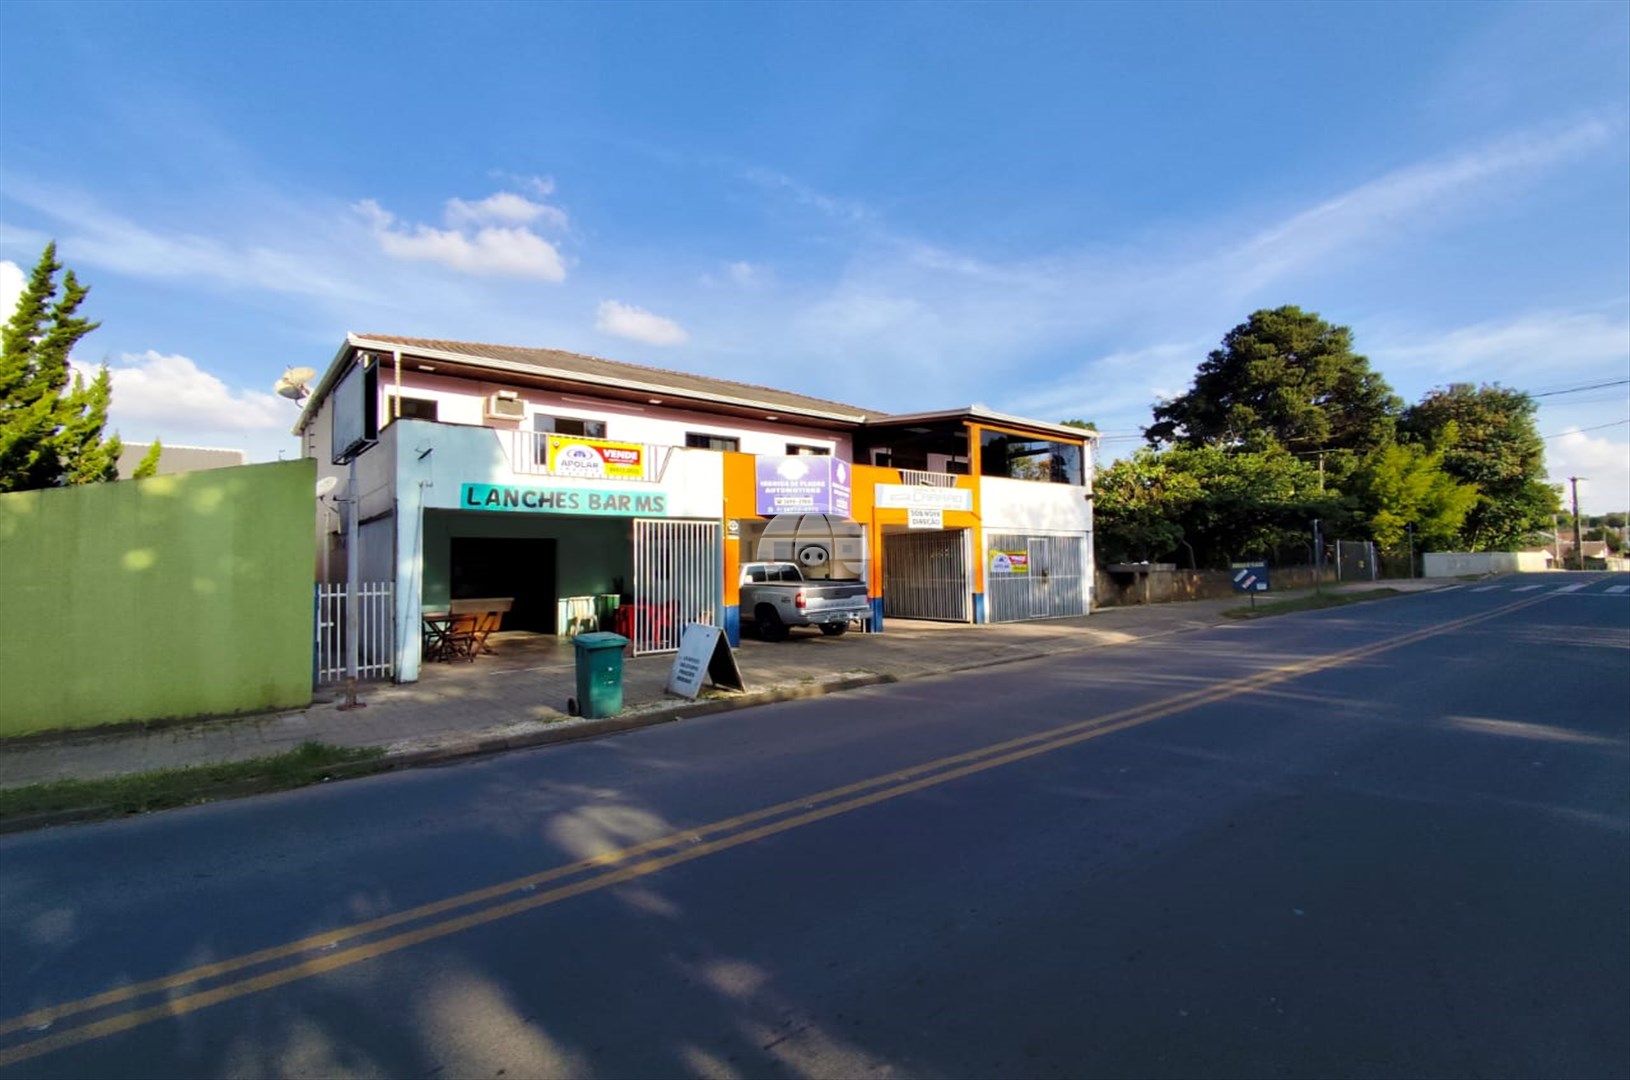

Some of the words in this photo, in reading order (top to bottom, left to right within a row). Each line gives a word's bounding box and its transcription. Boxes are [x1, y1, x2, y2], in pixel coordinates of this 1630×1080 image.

[602, 448, 639, 461] VENDE
[560, 459, 600, 469] APOLAR
[466, 486, 580, 510] LANCHES
[588, 493, 632, 512] BAR
